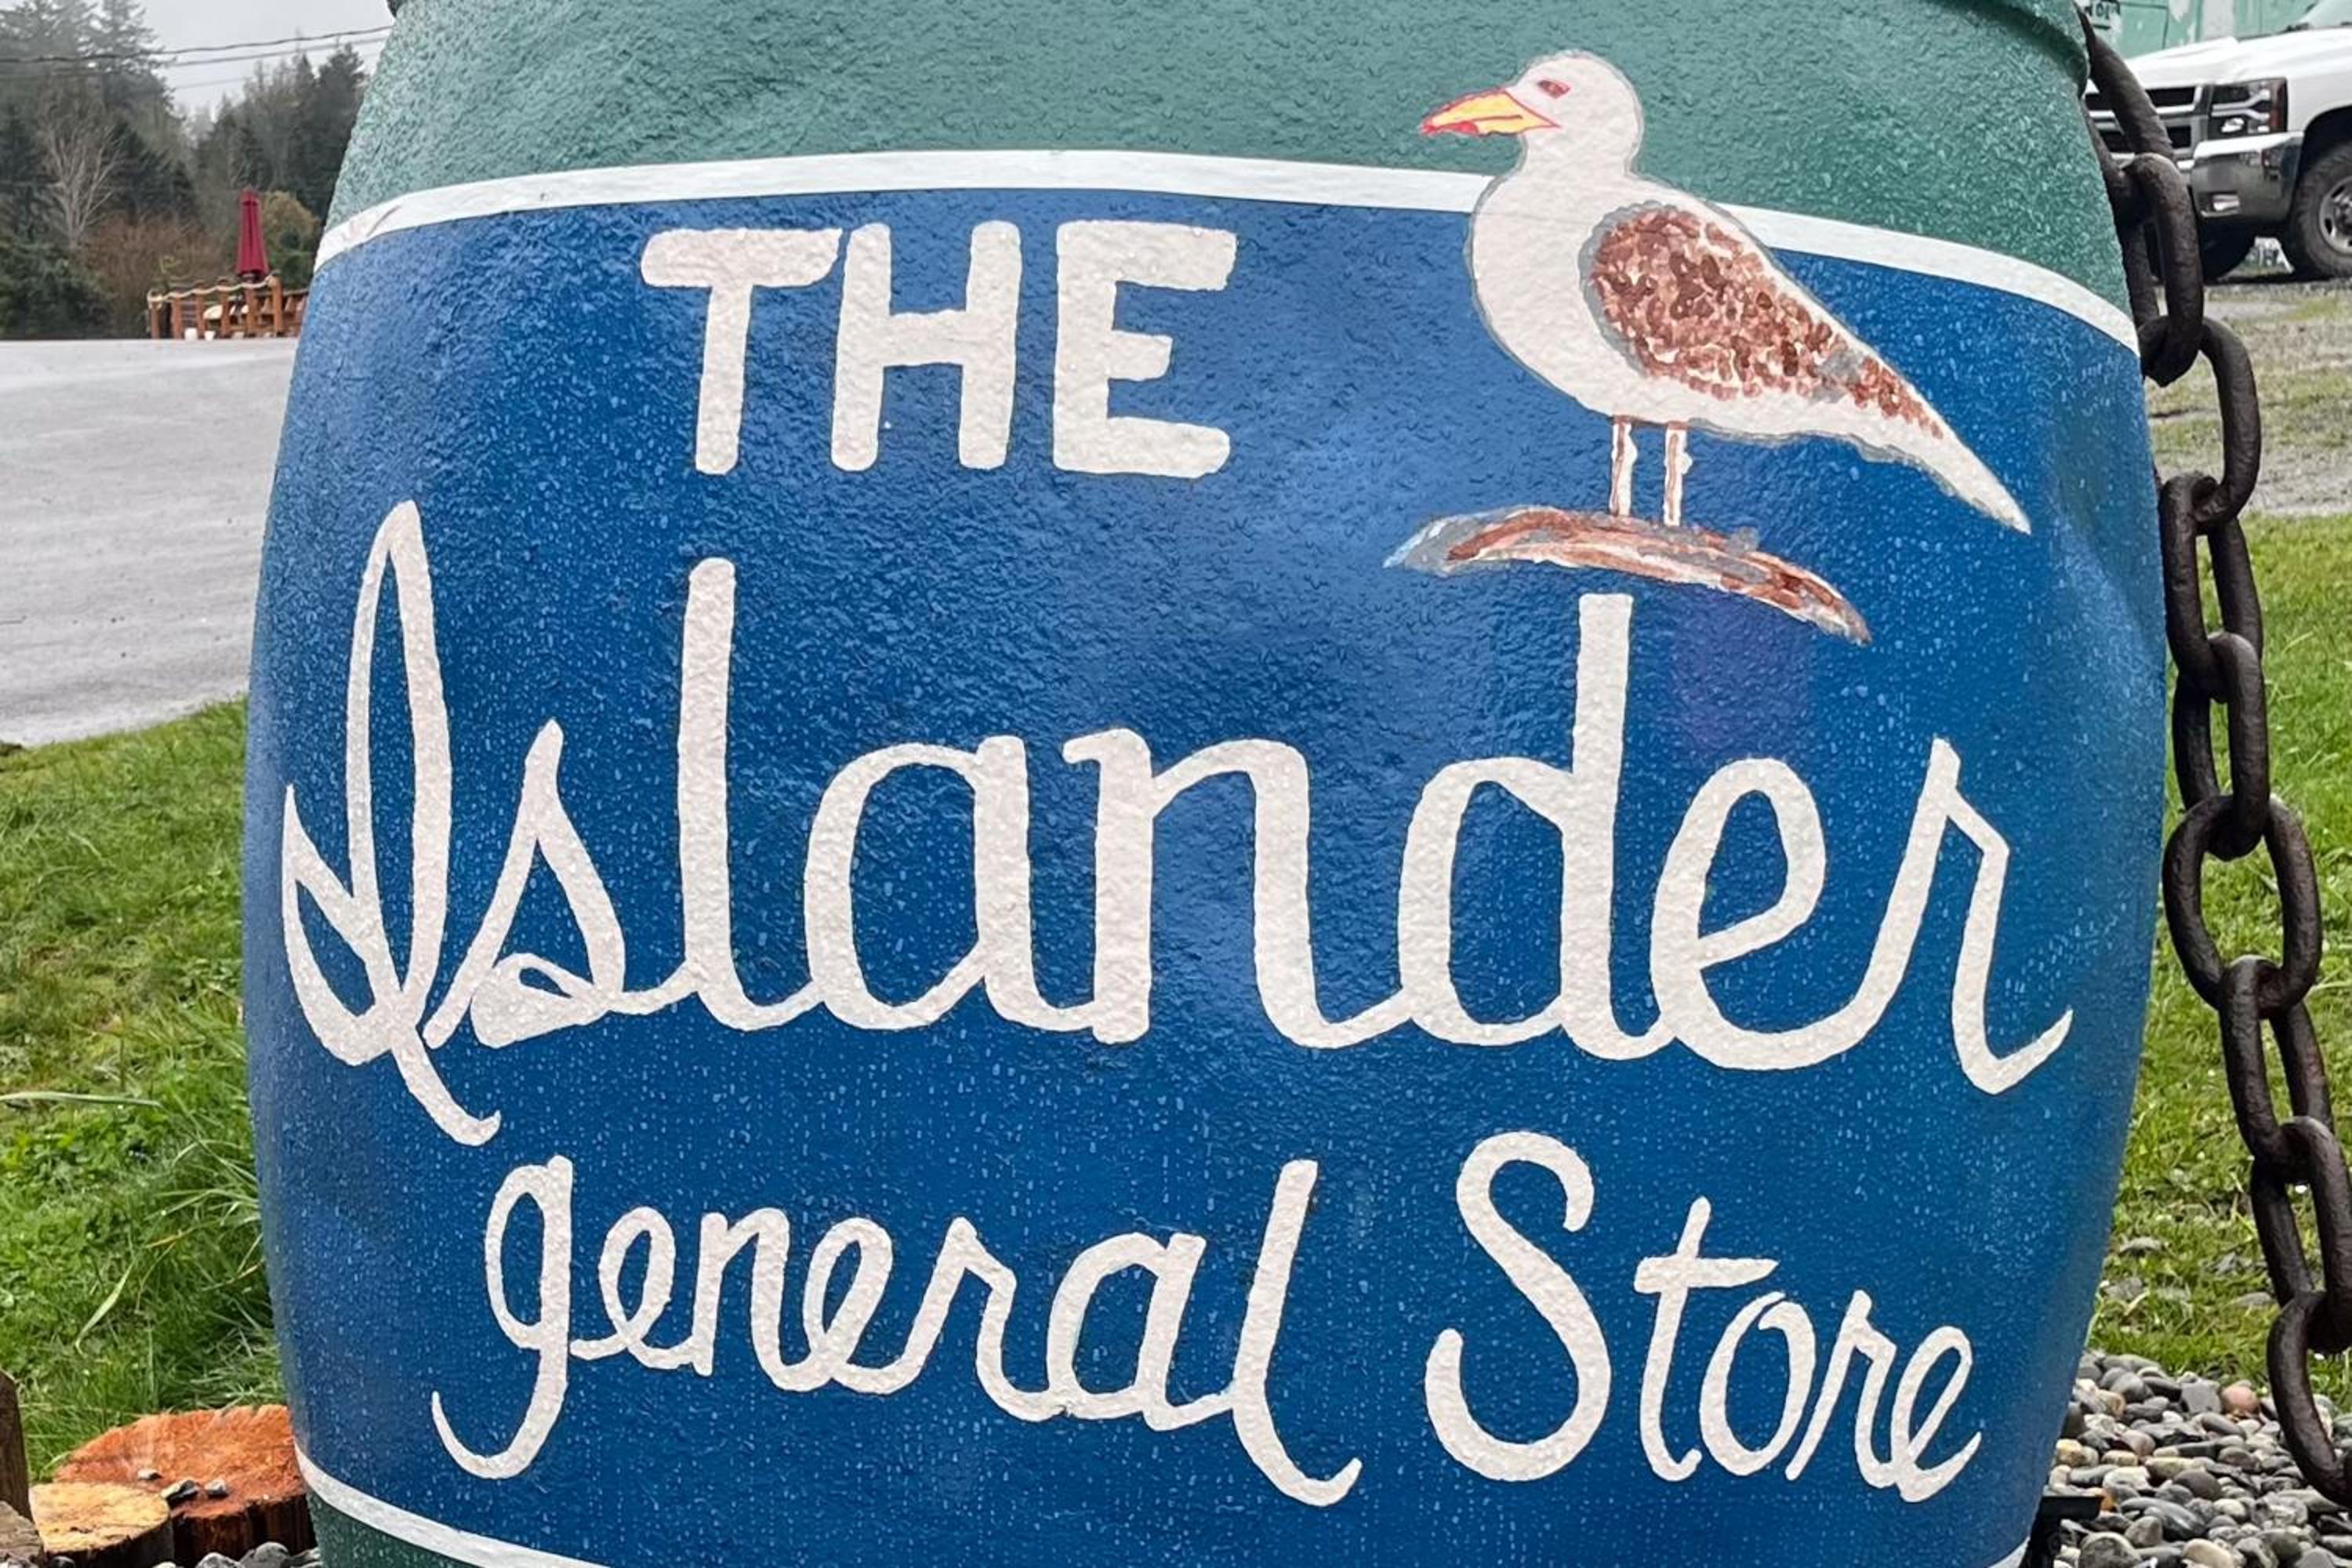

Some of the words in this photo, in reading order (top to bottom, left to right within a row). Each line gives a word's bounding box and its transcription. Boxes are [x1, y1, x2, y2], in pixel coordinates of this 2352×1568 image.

[641, 220, 1239, 479] THE
[282, 500, 2073, 1145] Islander
[432, 1156, 1363, 1507] general
[1425, 1131, 1982, 1502] Store
